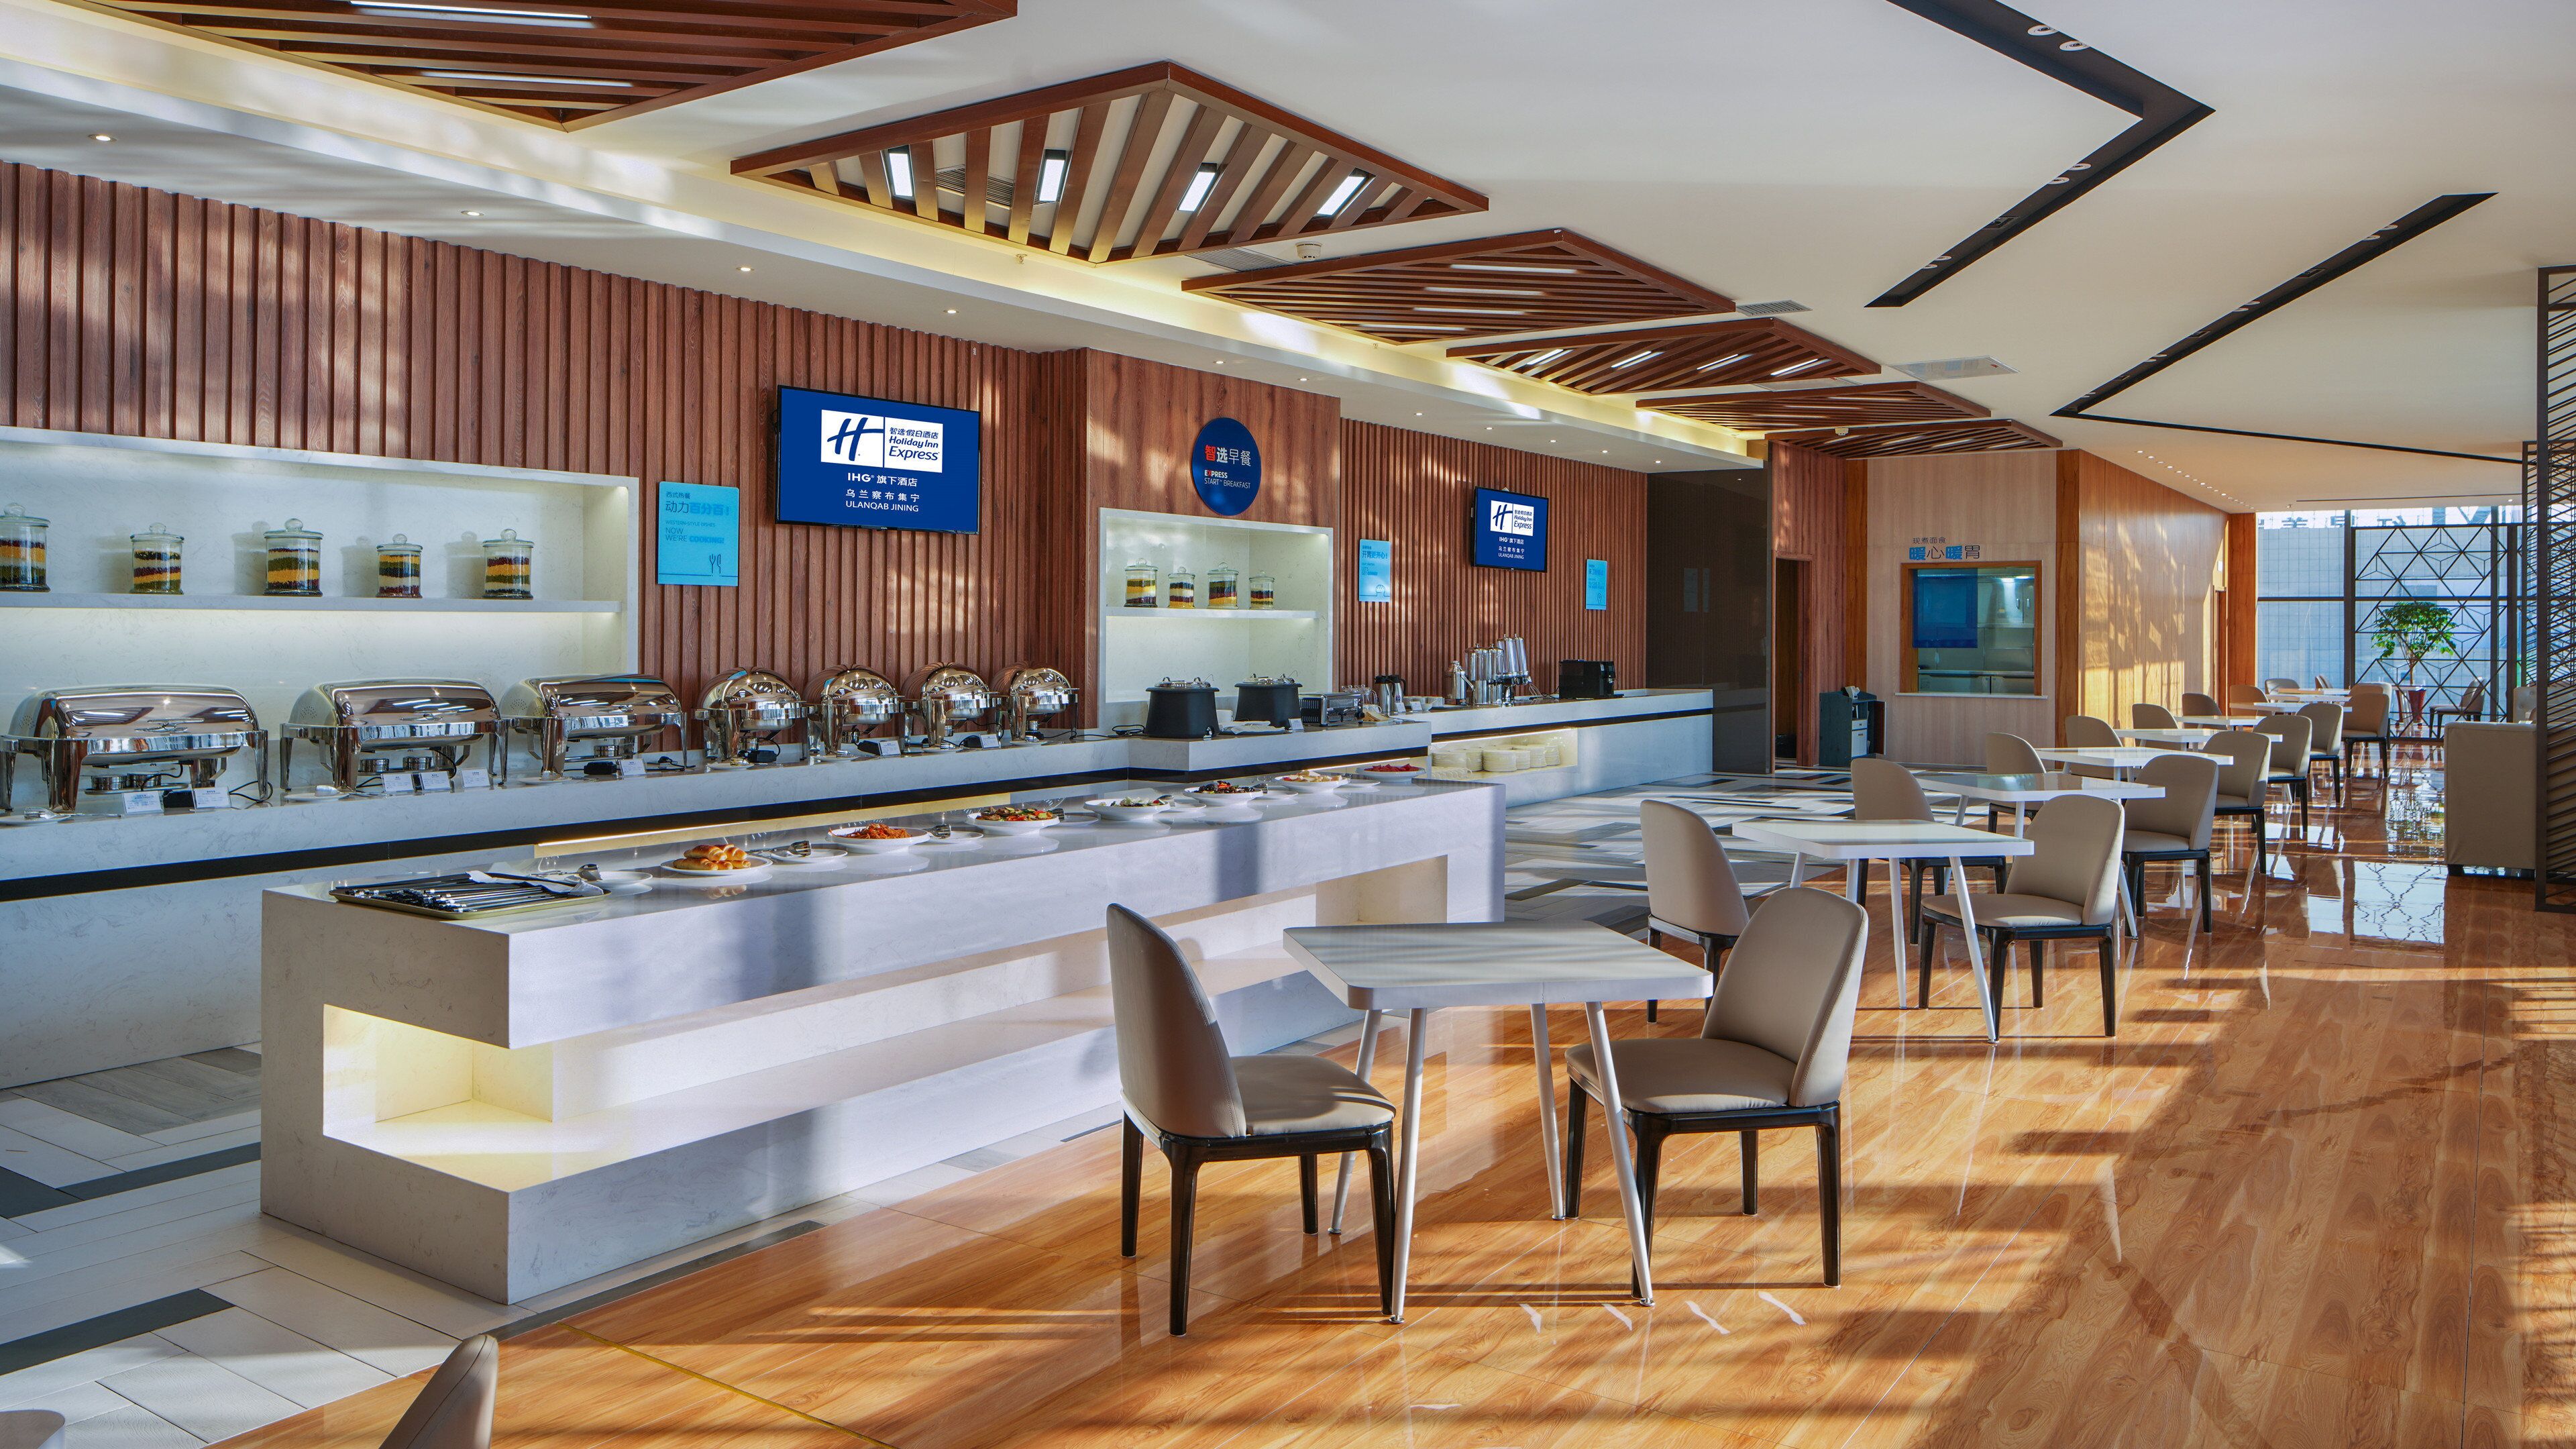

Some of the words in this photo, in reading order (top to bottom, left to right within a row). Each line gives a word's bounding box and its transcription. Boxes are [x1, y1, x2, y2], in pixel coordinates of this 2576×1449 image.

[890, 427, 938, 439] 智选假日酒店
[889, 436, 924, 448] Holiday
[925, 439, 938, 448] Inn
[889, 446, 938, 460] Express
[1205, 445, 1251, 466] 智选早餐
[877, 475, 918, 486] 旗下酒店
[1205, 470, 1228, 479] EXPRESS
[1224, 480, 1251, 489] BREAKFAST
[846, 488, 920, 502] 乌兰察布集宁
[846, 500, 889, 510] ULANQAB
[891, 504, 919, 512] JINING
[1514, 521, 1532, 529] Express
[1909, 545, 1980, 560] 暖心暖胃
